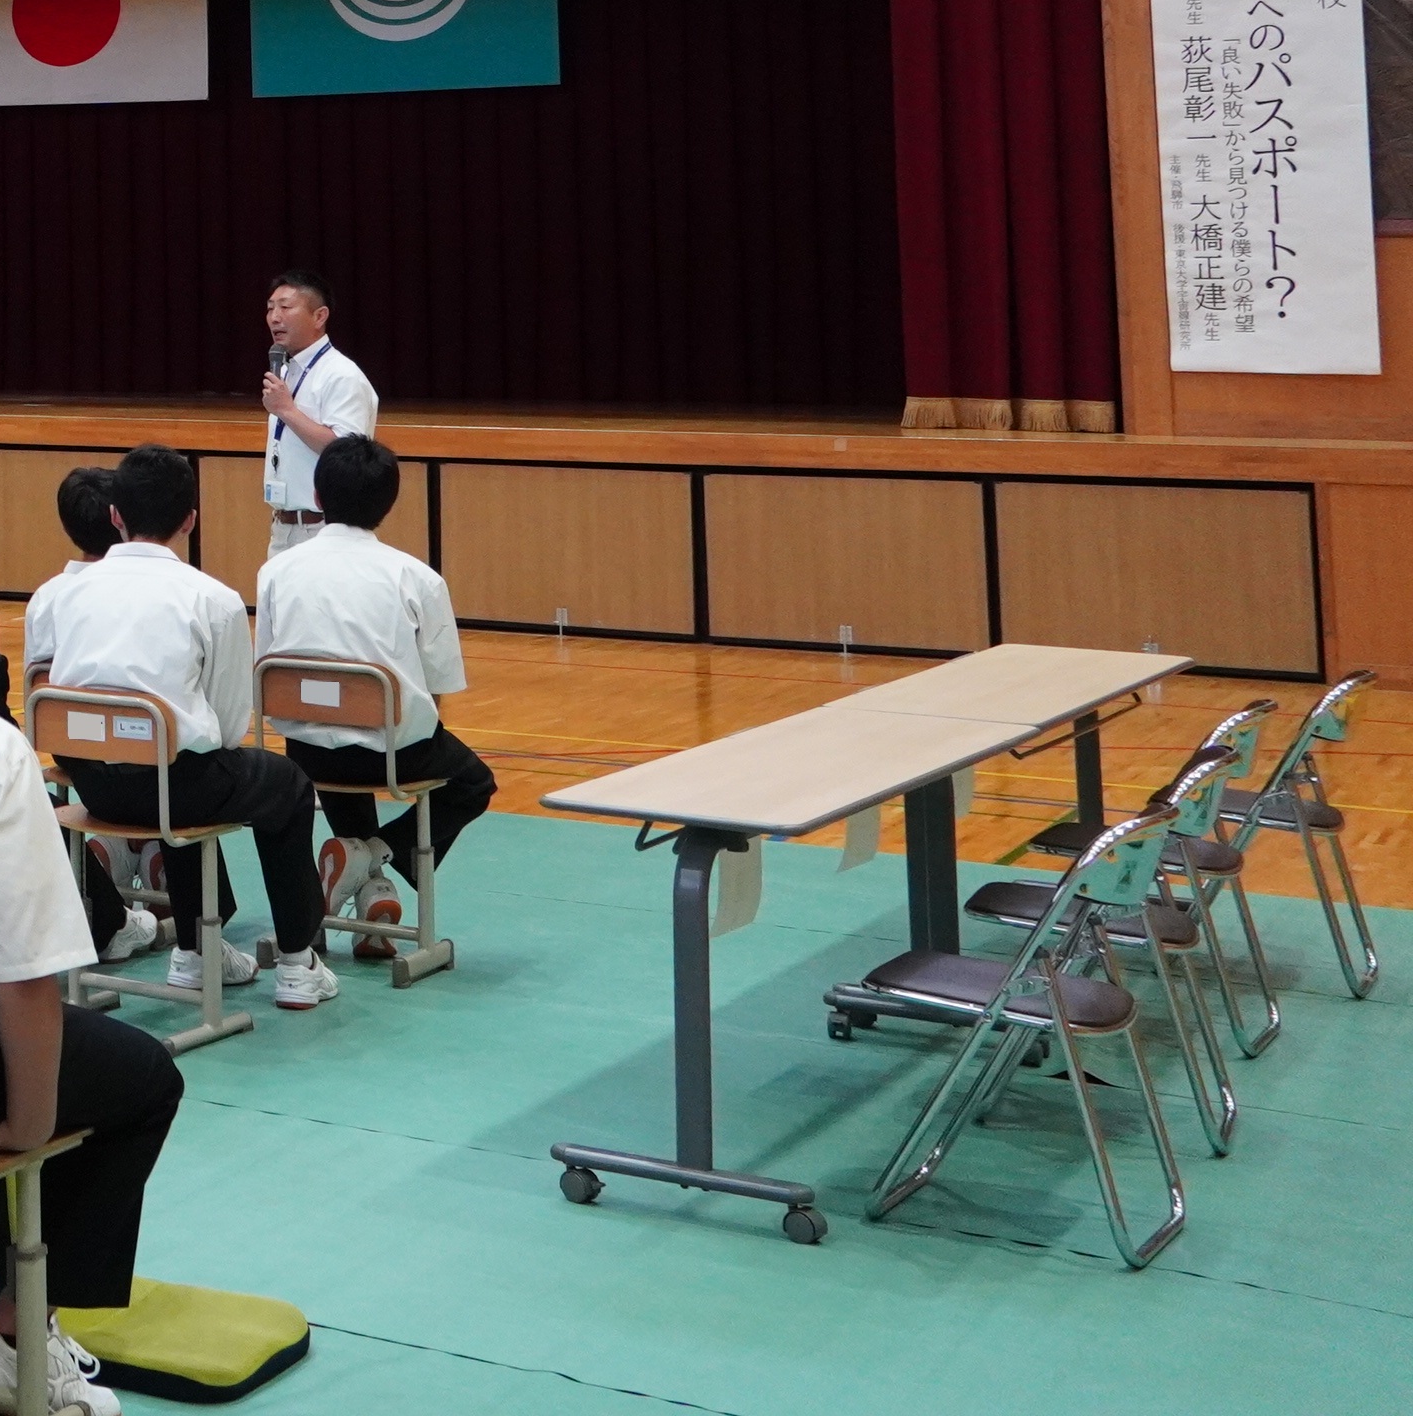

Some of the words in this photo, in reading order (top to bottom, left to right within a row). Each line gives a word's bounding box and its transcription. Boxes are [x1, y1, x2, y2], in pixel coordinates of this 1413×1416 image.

[1220, 38, 1255, 333] 「良い失敗」から見つける僕らの希望
